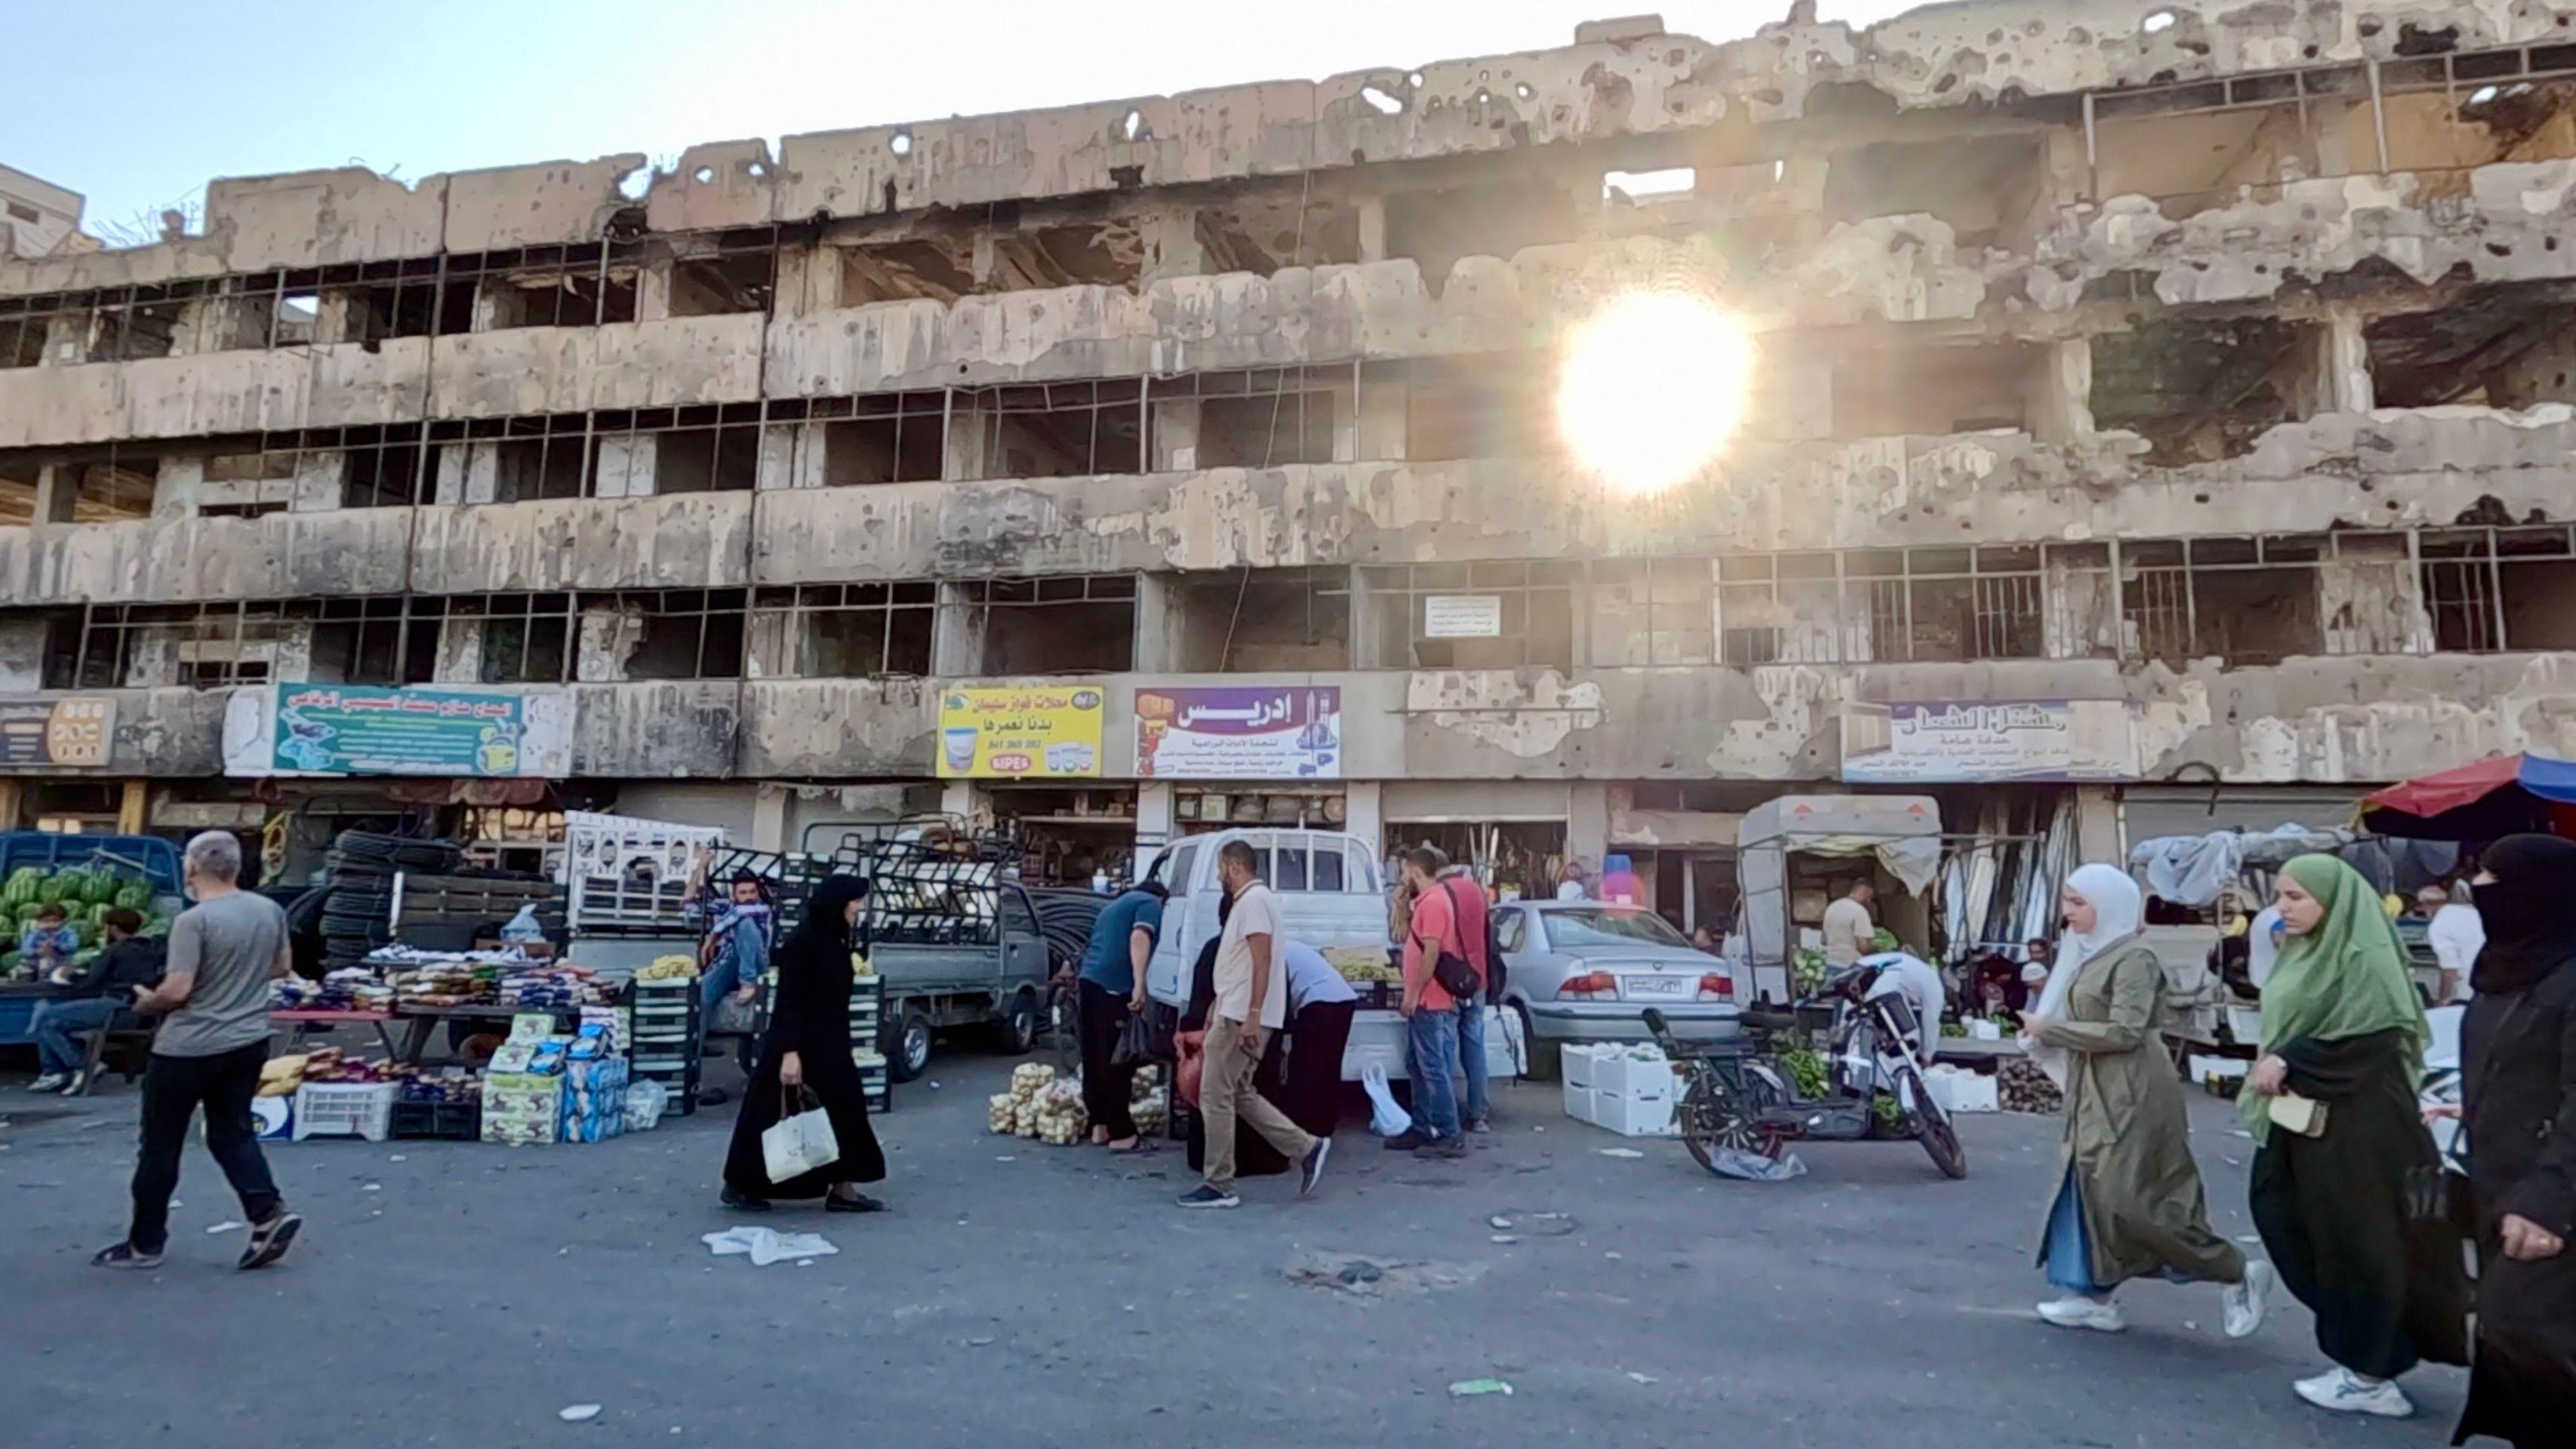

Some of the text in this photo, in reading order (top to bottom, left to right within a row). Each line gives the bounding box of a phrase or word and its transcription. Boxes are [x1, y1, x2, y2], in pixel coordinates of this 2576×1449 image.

[1177, 692, 1292, 728] إدريس
[983, 715, 1052, 734] بدنا نعمرها
[993, 756, 1029, 770] SIPES
